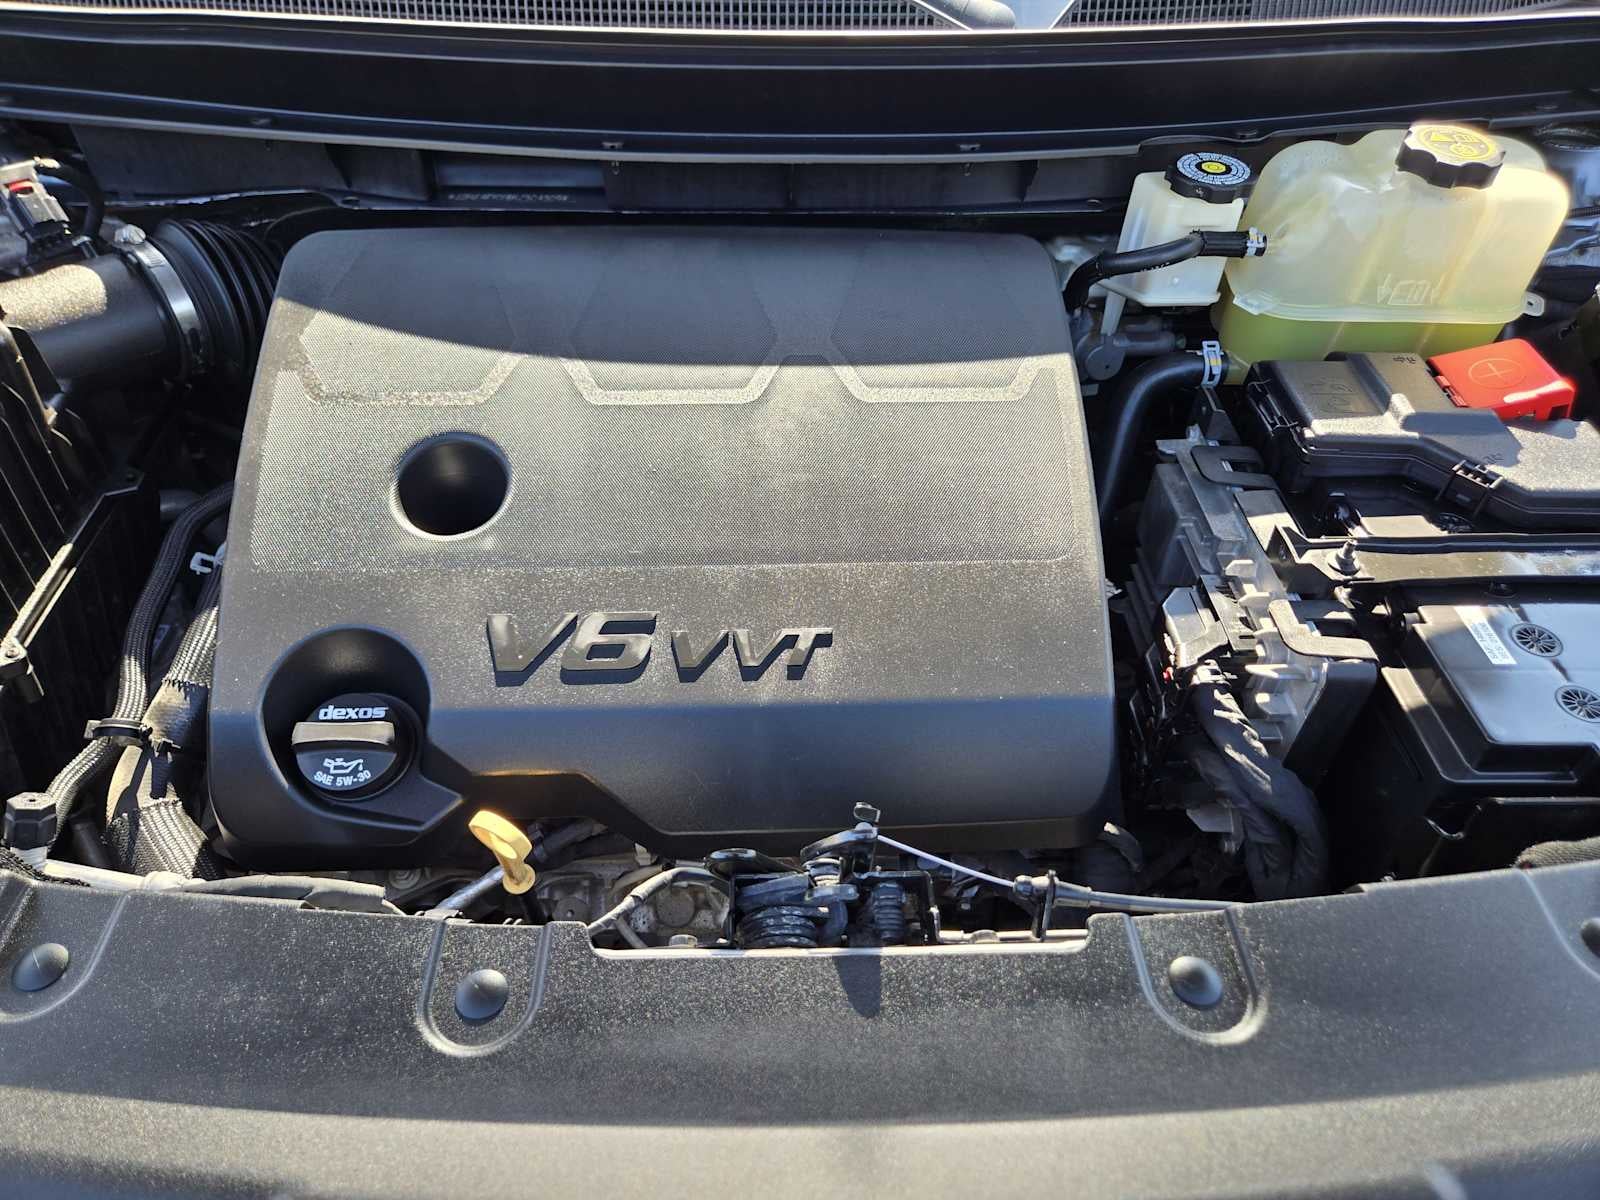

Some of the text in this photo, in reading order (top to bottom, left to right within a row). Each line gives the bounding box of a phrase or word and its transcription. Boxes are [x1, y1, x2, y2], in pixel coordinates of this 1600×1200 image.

[486, 611, 833, 685] V6 VVT
[319, 705, 389, 720] dexos
[313, 769, 371, 786] SAE 5W-30
